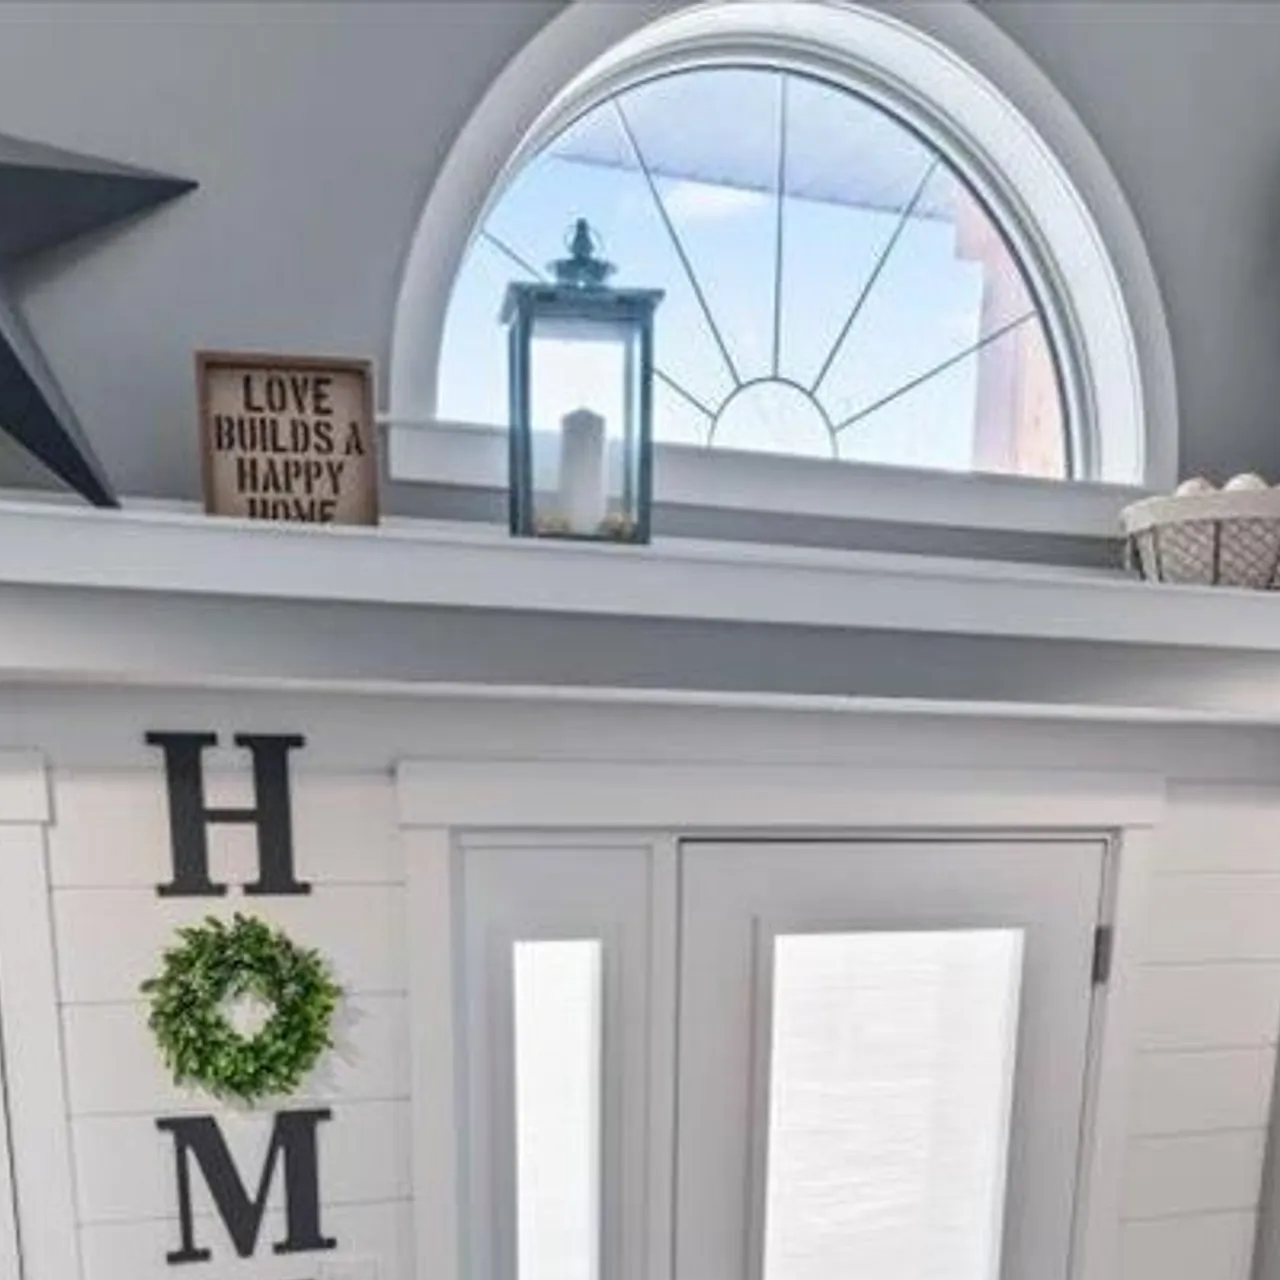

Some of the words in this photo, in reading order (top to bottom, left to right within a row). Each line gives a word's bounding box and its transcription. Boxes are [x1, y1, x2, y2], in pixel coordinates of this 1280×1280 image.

[243, 374, 334, 416] LOVE
[214, 414, 334, 454] BUILDS
[345, 421, 366, 456] A
[237, 457, 344, 495] HAPPY
